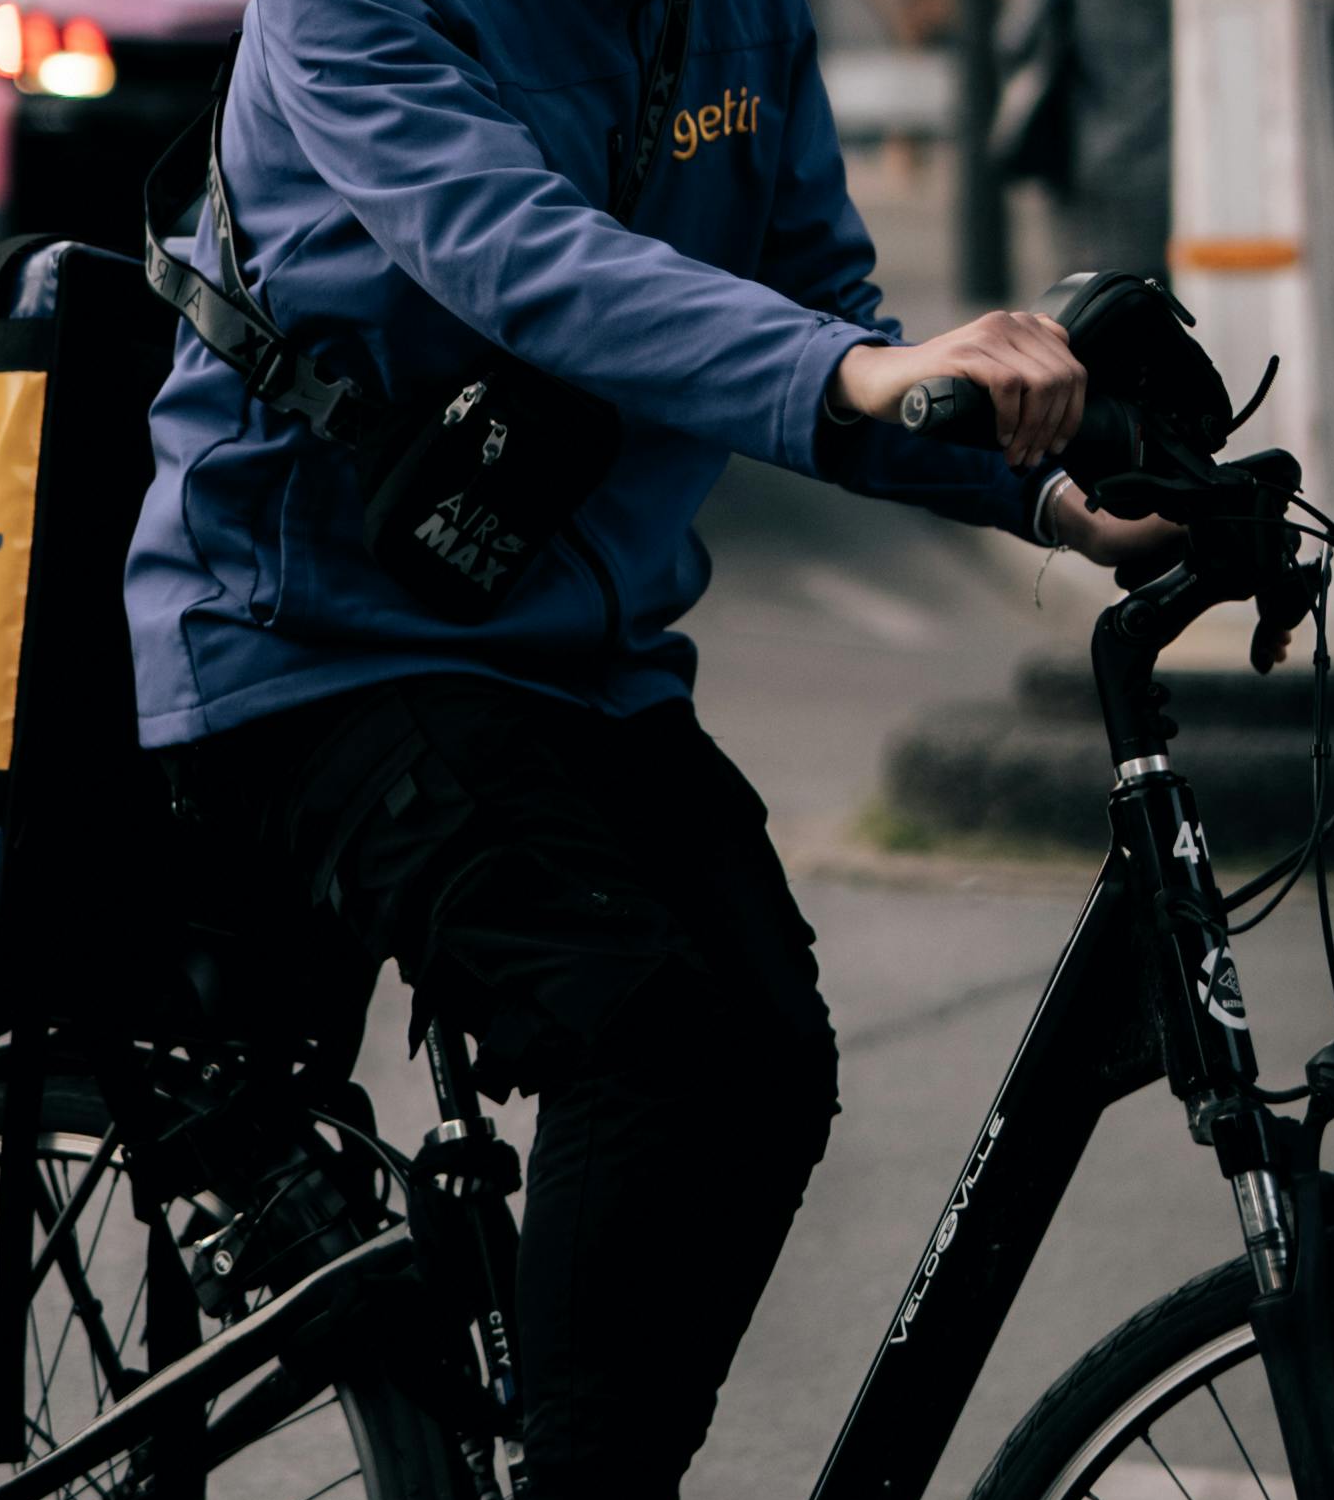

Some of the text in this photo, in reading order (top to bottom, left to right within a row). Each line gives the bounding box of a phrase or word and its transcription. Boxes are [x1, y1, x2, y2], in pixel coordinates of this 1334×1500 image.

[672, 86, 761, 160] getir
[436, 492, 499, 544] AIR
[414, 512, 508, 592] MAX
[487, 1309, 513, 1368] CITY
